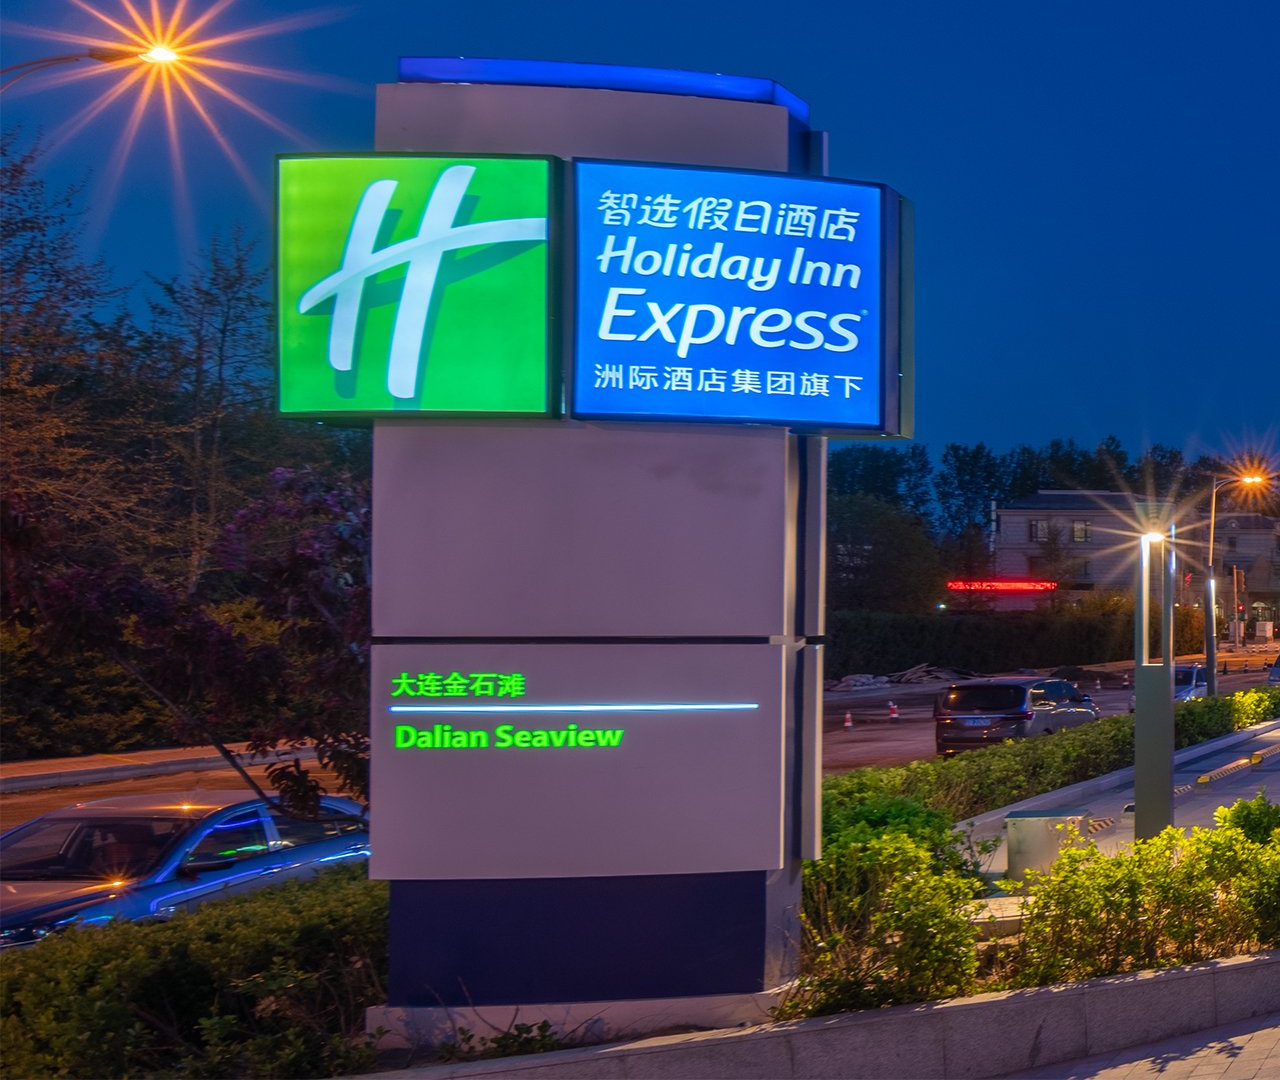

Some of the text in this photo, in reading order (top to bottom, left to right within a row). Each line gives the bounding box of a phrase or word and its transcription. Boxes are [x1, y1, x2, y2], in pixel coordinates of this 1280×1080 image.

[597, 188, 861, 242] 智选假日酒店
[596, 234, 862, 292] Holiday Inn
[598, 287, 862, 359] Express
[594, 362, 864, 399] 洲际酒店集团旗下
[391, 672, 526, 698] 大连金石滩
[395, 723, 625, 749] Dalian Seaview
